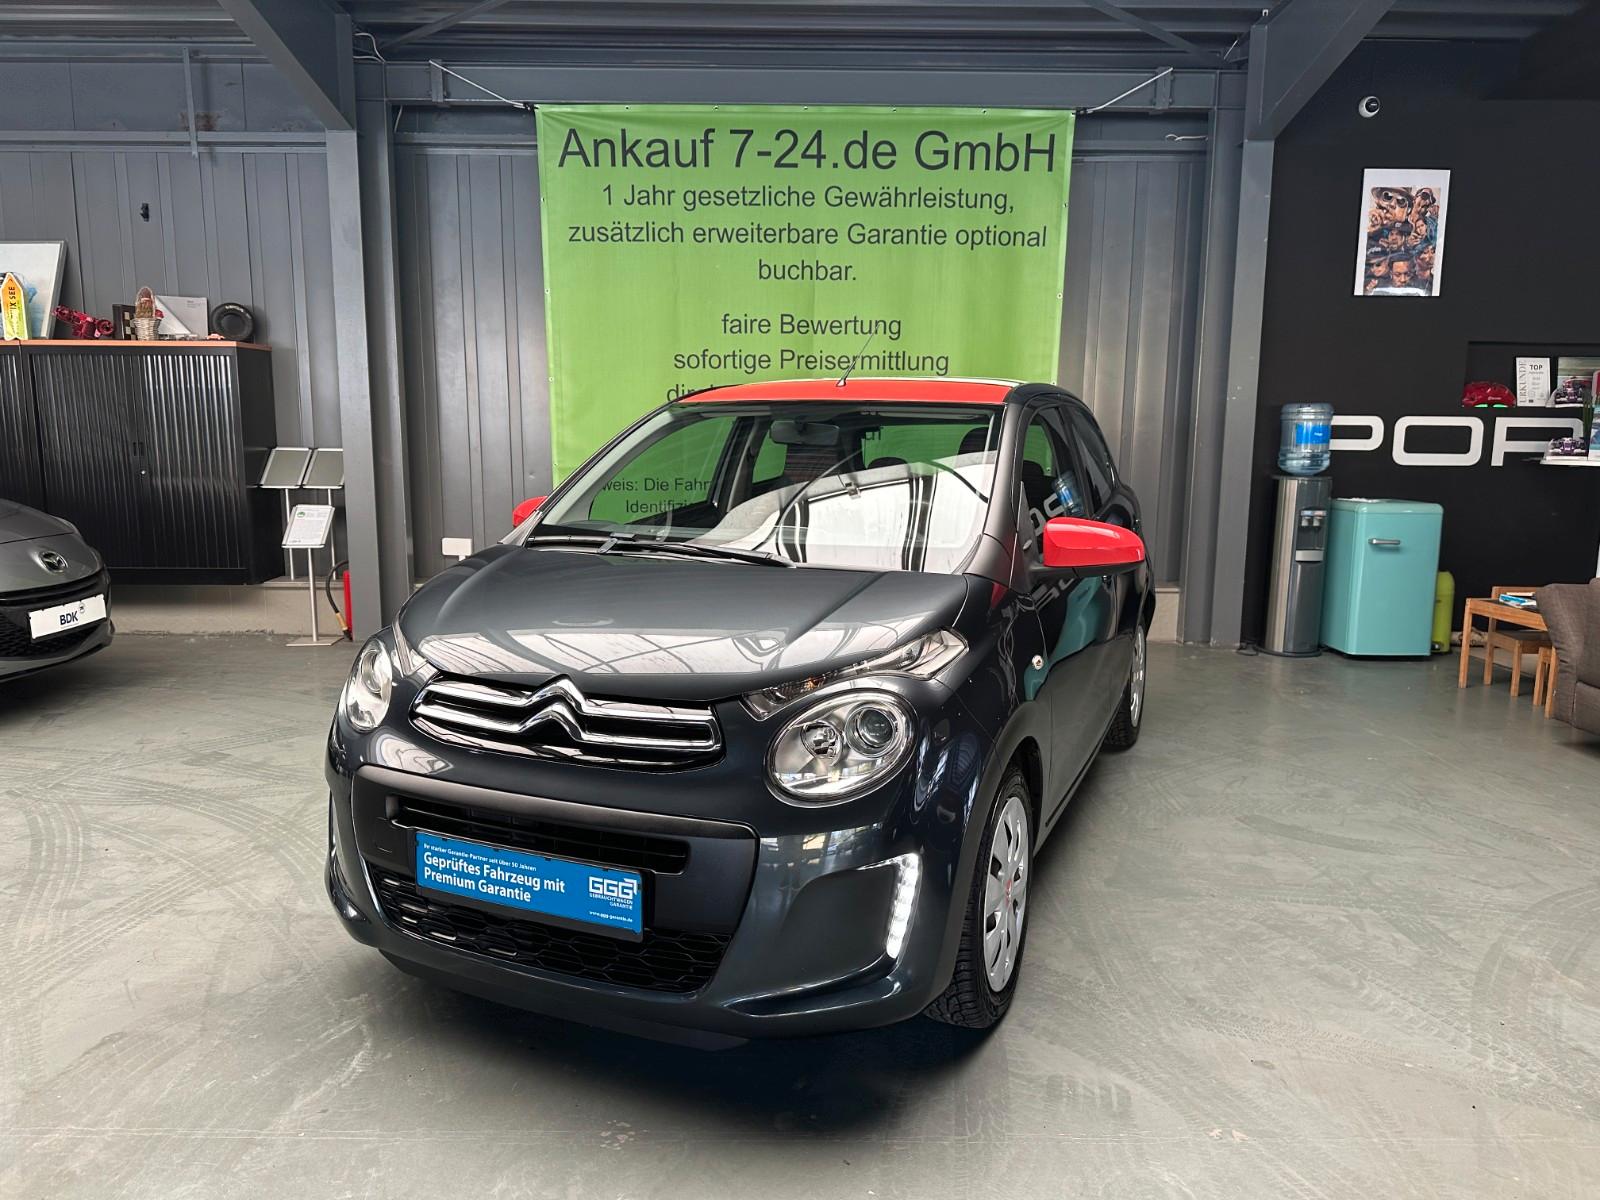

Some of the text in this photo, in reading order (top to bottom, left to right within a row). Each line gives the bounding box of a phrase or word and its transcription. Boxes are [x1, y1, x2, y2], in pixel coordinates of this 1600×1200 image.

[558, 127, 1057, 173] Ankauf 7-24.de GmbH
[602, 183, 1015, 215] 1 Jahr gesetzliche Gewährleistung,
[568, 221, 1048, 251] zusätzlich erweiterbare Garantie optional
[758, 258, 857, 282] buchbar.
[721, 313, 902, 341] faire Bewertung
[673, 348, 950, 377] sofortige Preisermittlung
[1529, 363, 1544, 372] TOP
[602, 477, 712, 492] weis: Die Fahr
[59, 610, 79, 626] BDK
[423, 851, 566, 894] Geprüftes Fahrzeug mit
[423, 866, 532, 903] Premium Garantie
